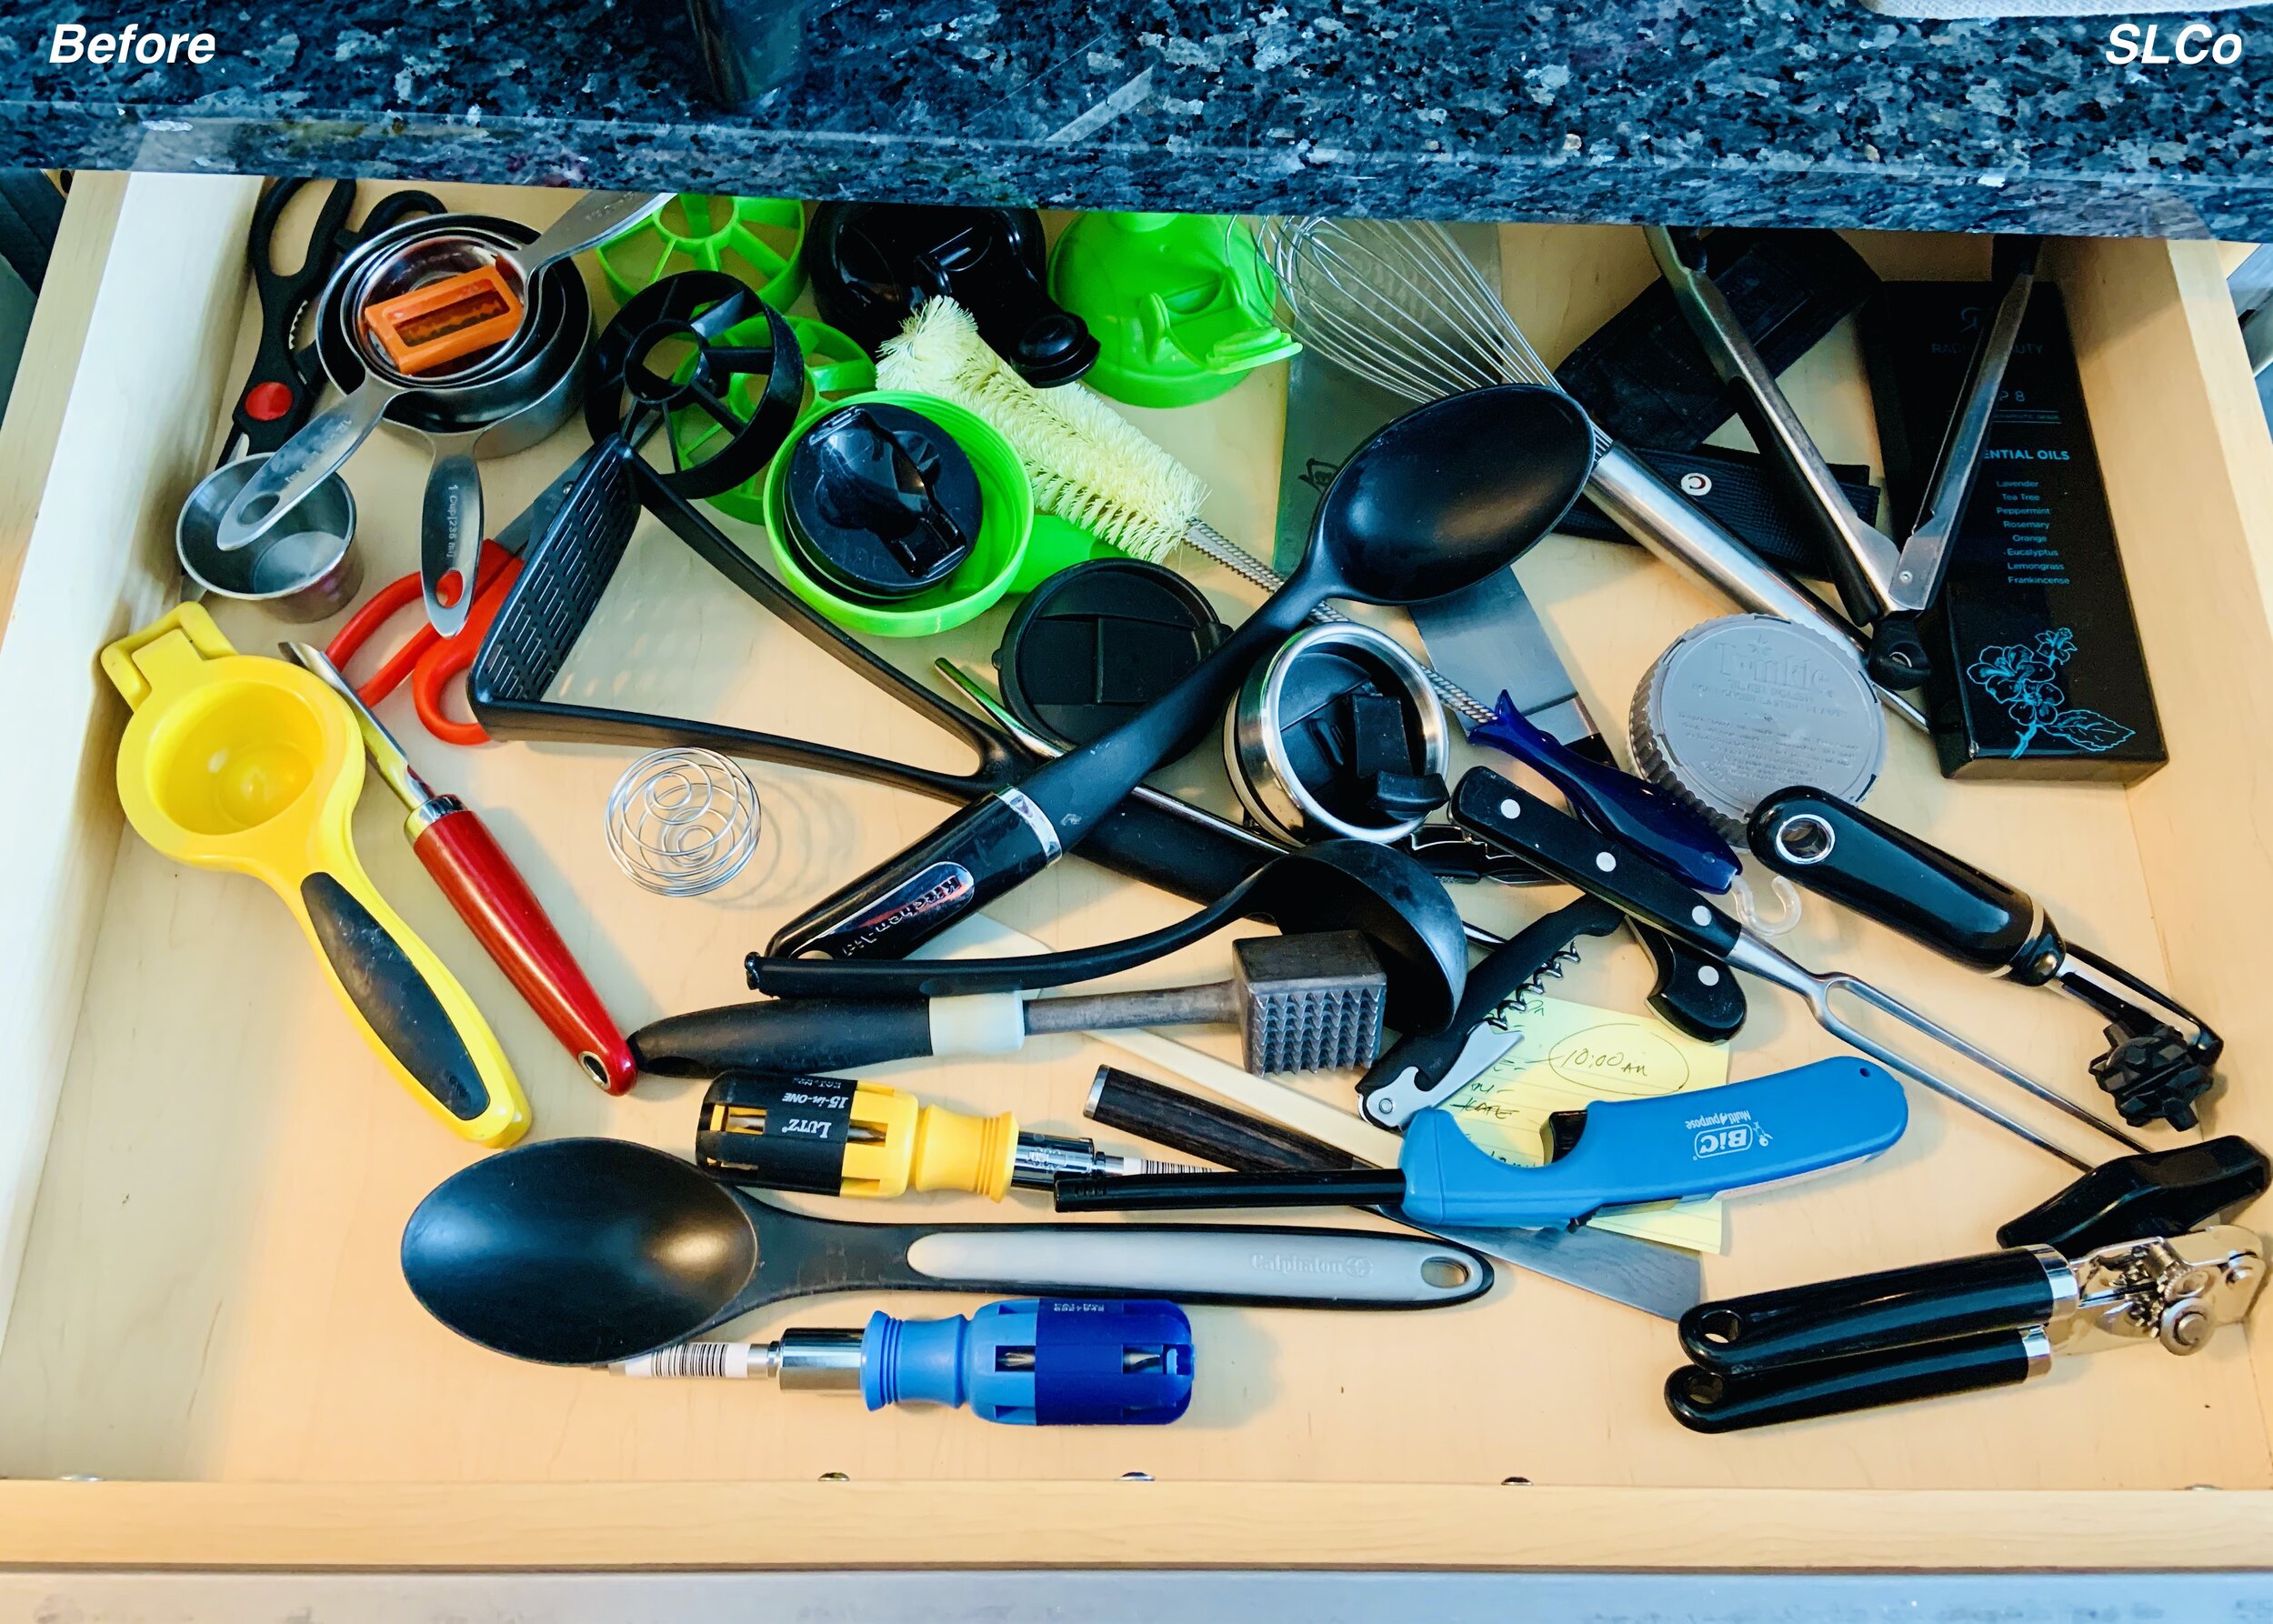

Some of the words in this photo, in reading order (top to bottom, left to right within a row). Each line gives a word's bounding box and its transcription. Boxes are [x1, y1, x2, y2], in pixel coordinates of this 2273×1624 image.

[1984, 449, 2034, 460] ENTIAL
[2037, 449, 2071, 461] OILS
[1996, 480, 2039, 488] Lavender
[1996, 506, 2052, 516] Peppermint
[2003, 521, 2050, 530] Rosemary
[2012, 535, 2048, 544] Orange
[2007, 548, 2059, 557] Eucalyptus
[2007, 562, 2066, 571] Lemongrass
[2008, 576, 2071, 586] Frankincense
[782, 1092, 849, 1108] 15-in-ONE
[1685, 1113, 1720, 1129] purpose
[1251, 1253, 1344, 1275] Calphalon
